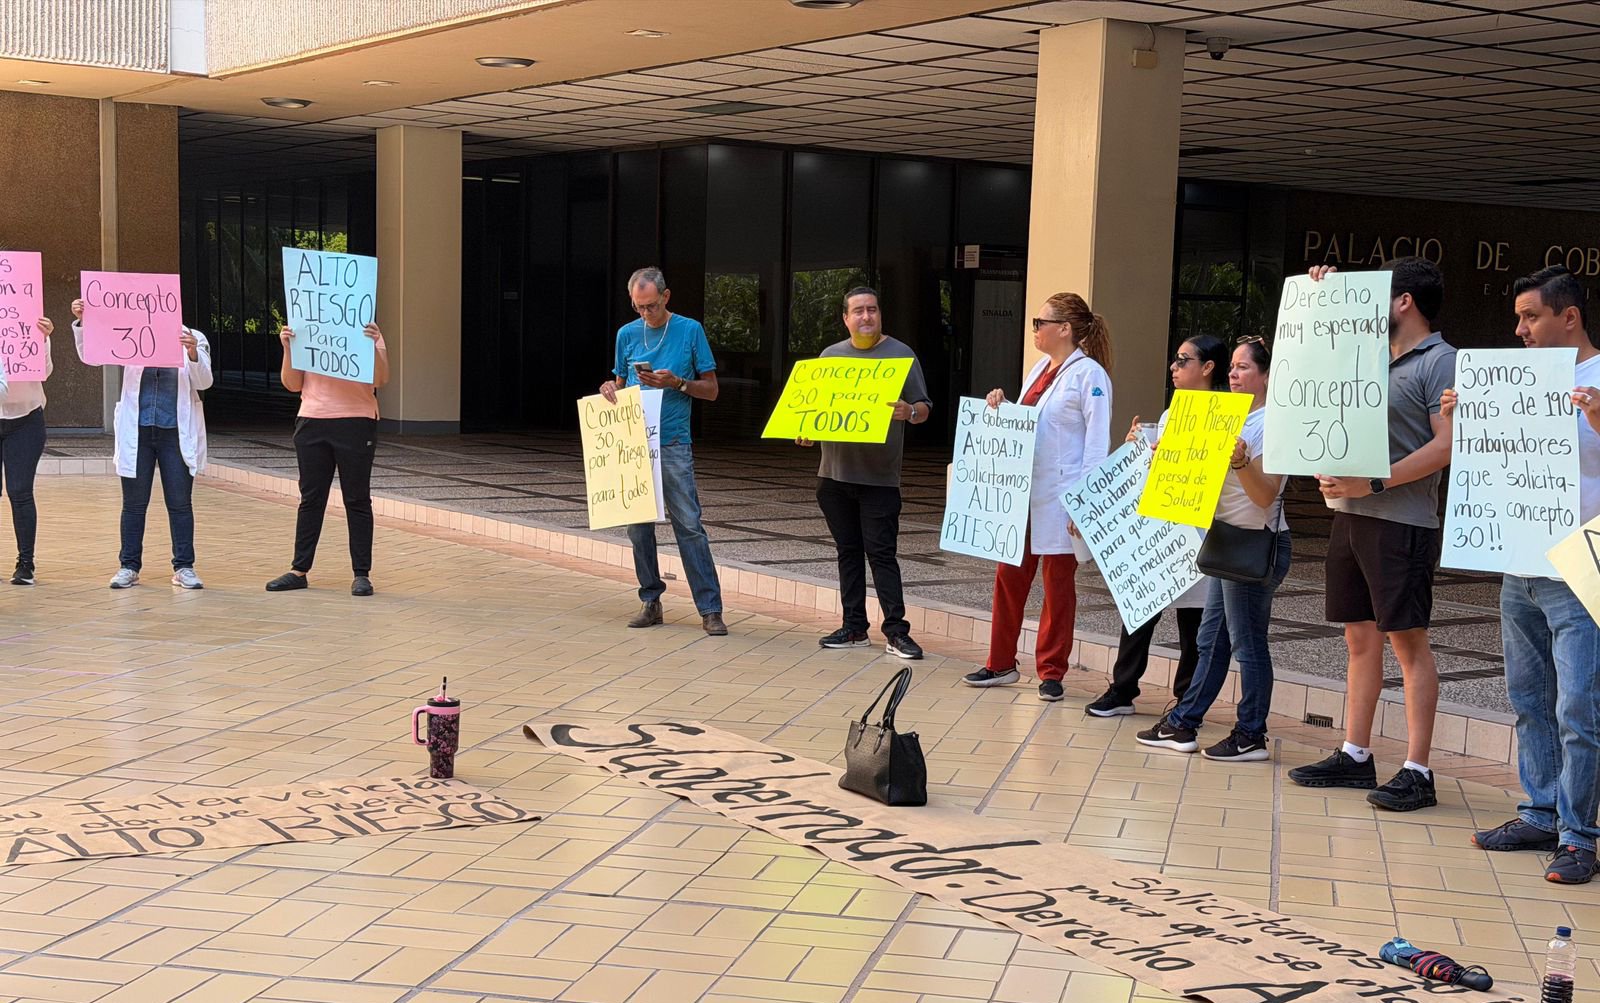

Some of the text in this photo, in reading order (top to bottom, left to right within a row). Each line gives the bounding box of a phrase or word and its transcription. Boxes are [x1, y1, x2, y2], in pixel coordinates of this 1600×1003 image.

[297, 252, 358, 288] ALTO
[1303, 230, 1443, 266] PALACIO
[1476, 240, 1511, 271] DE
[86, 279, 178, 325] Concepto
[290, 288, 373, 329] RIESGO
[1284, 275, 1371, 310] Derecho
[111, 326, 156, 360] 30
[305, 324, 348, 352] Para
[1279, 304, 1388, 350] muy esperado
[20, 341, 39, 359] 30
[304, 346, 361, 378] TODOS
[793, 360, 896, 388] Concepto
[1273, 345, 1382, 423] Concepto
[1460, 353, 1537, 390] Somos
[585, 394, 642, 437] Concepto
[787, 387, 879, 409] 30 para
[1459, 389, 1574, 421] más de 190
[595, 431, 615, 450] 30
[795, 409, 870, 433] TODOS
[1162, 394, 1241, 450] Alto Riesgo
[1299, 420, 1348, 461] 30
[588, 439, 646, 479] por Riesgo
[1153, 448, 1180, 473] para
[1456, 423, 1572, 469] trabajadores
[956, 458, 1030, 493] Solicitamos
[1064, 435, 1149, 512] Sr. Gobernador
[1193, 467, 1207, 485] de
[1456, 461, 1576, 501] que solicita-
[591, 474, 649, 517] para todos
[968, 485, 1012, 514] ALTO
[1080, 468, 1142, 529] solicitamos
[945, 511, 1018, 559] RIESGO
[1453, 497, 1574, 535] mos concepto
[1099, 514, 1150, 569] para que
[1139, 533, 1187, 577] mediano
[1453, 522, 1503, 551] 30!!
[1108, 561, 1129, 583] nos
[1123, 548, 1196, 612] y alto riesgo
[6, 801, 527, 863] ALTO RIESGO
[960, 890, 1195, 971] Derecho
[1044, 885, 1167, 917] para
[1160, 922, 1253, 944] que
[1255, 952, 1322, 971] se
